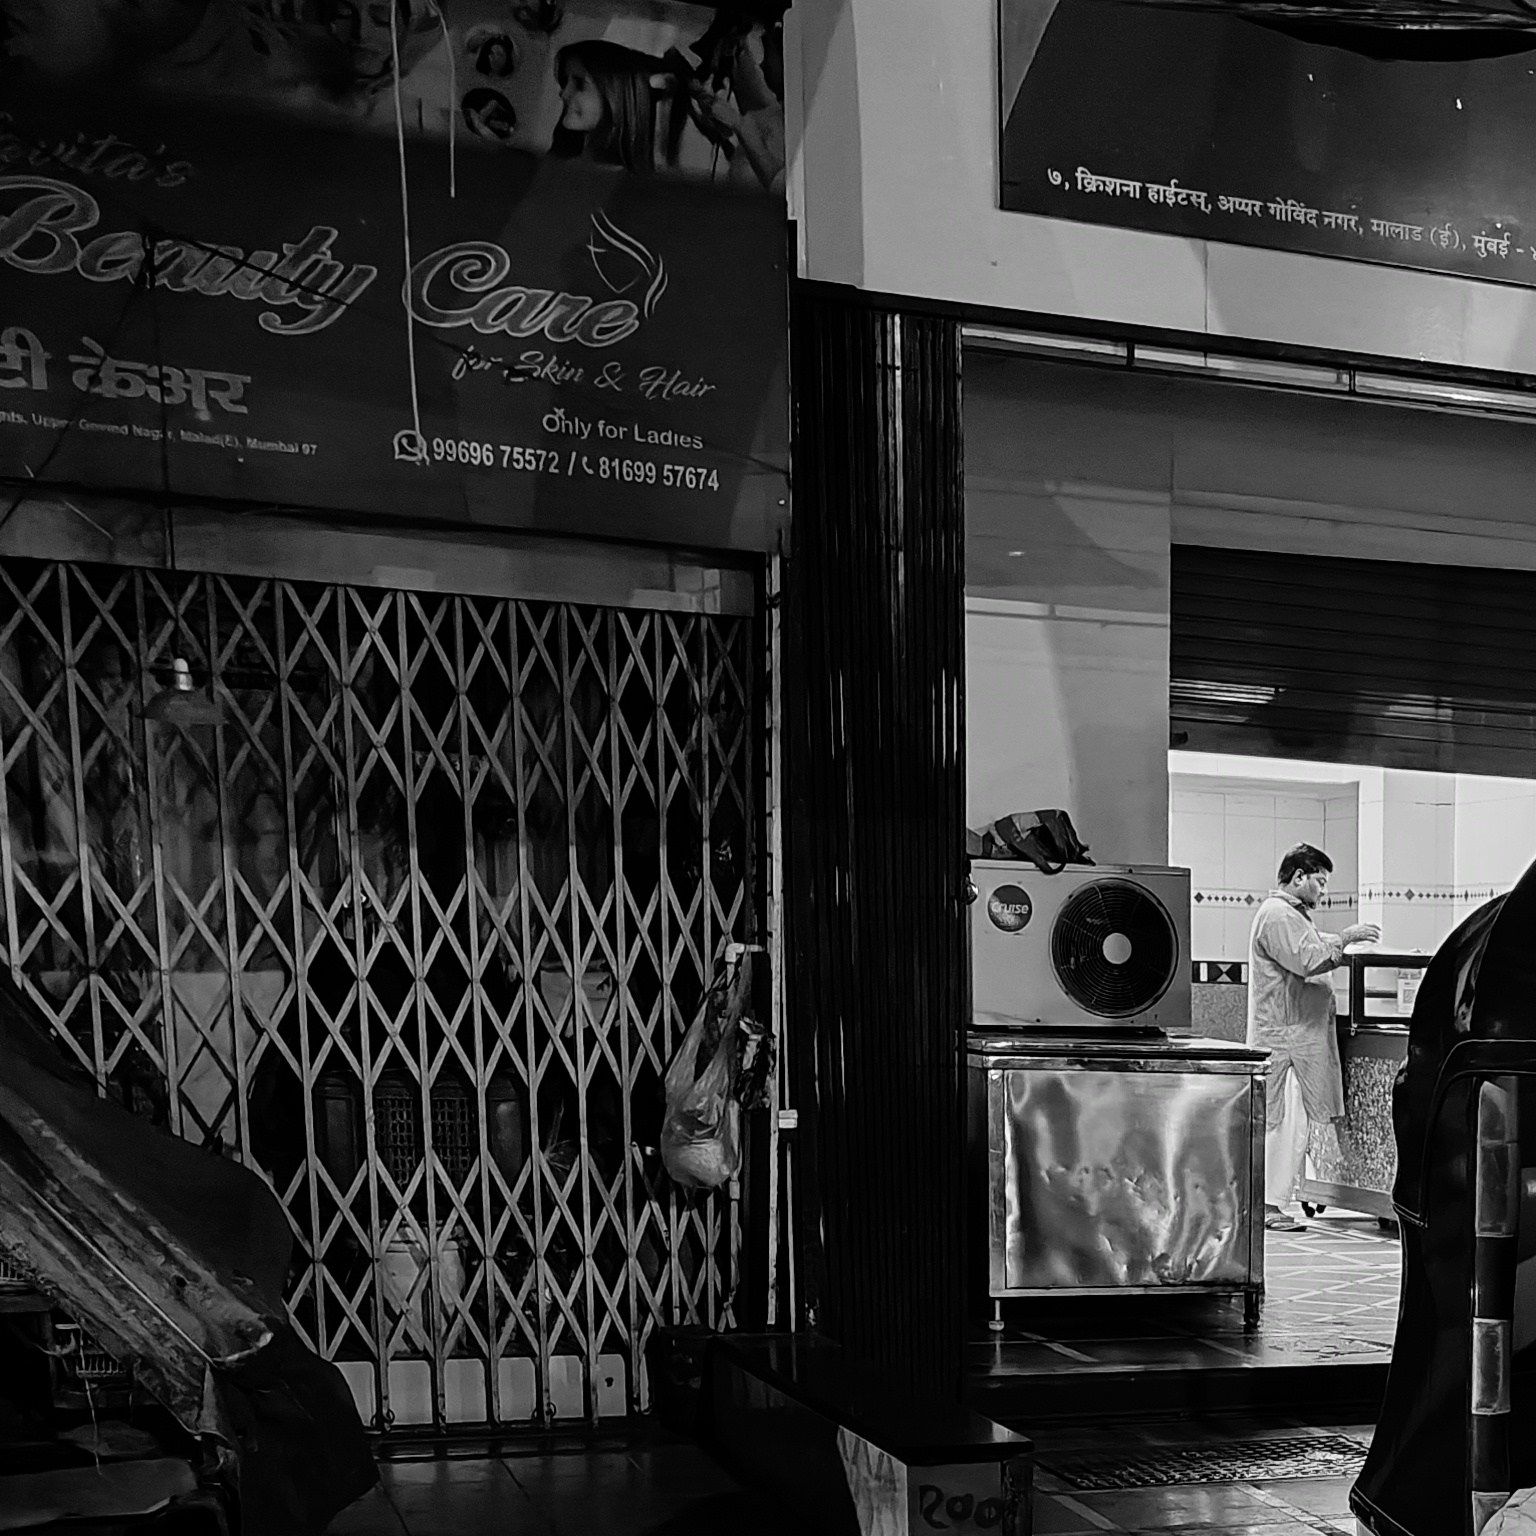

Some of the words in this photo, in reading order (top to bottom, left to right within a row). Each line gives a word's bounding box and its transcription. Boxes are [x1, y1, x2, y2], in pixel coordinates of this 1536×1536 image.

[0, 175, 378, 335] Beauty
[402, 241, 639, 347] Care
[1472, 230, 1511, 259] मुंबई
[504, 351, 584, 385] Skin
[594, 362, 622, 391] &
[639, 366, 716, 401] Hair
[542, 414, 592, 439] Only
[598, 420, 628, 440] for
[634, 424, 703, 449] Ladies
[432, 437, 494, 467] 99696
[499, 445, 559, 474] 75572
[599, 457, 656, 484] 81699
[663, 465, 719, 491] 57674
